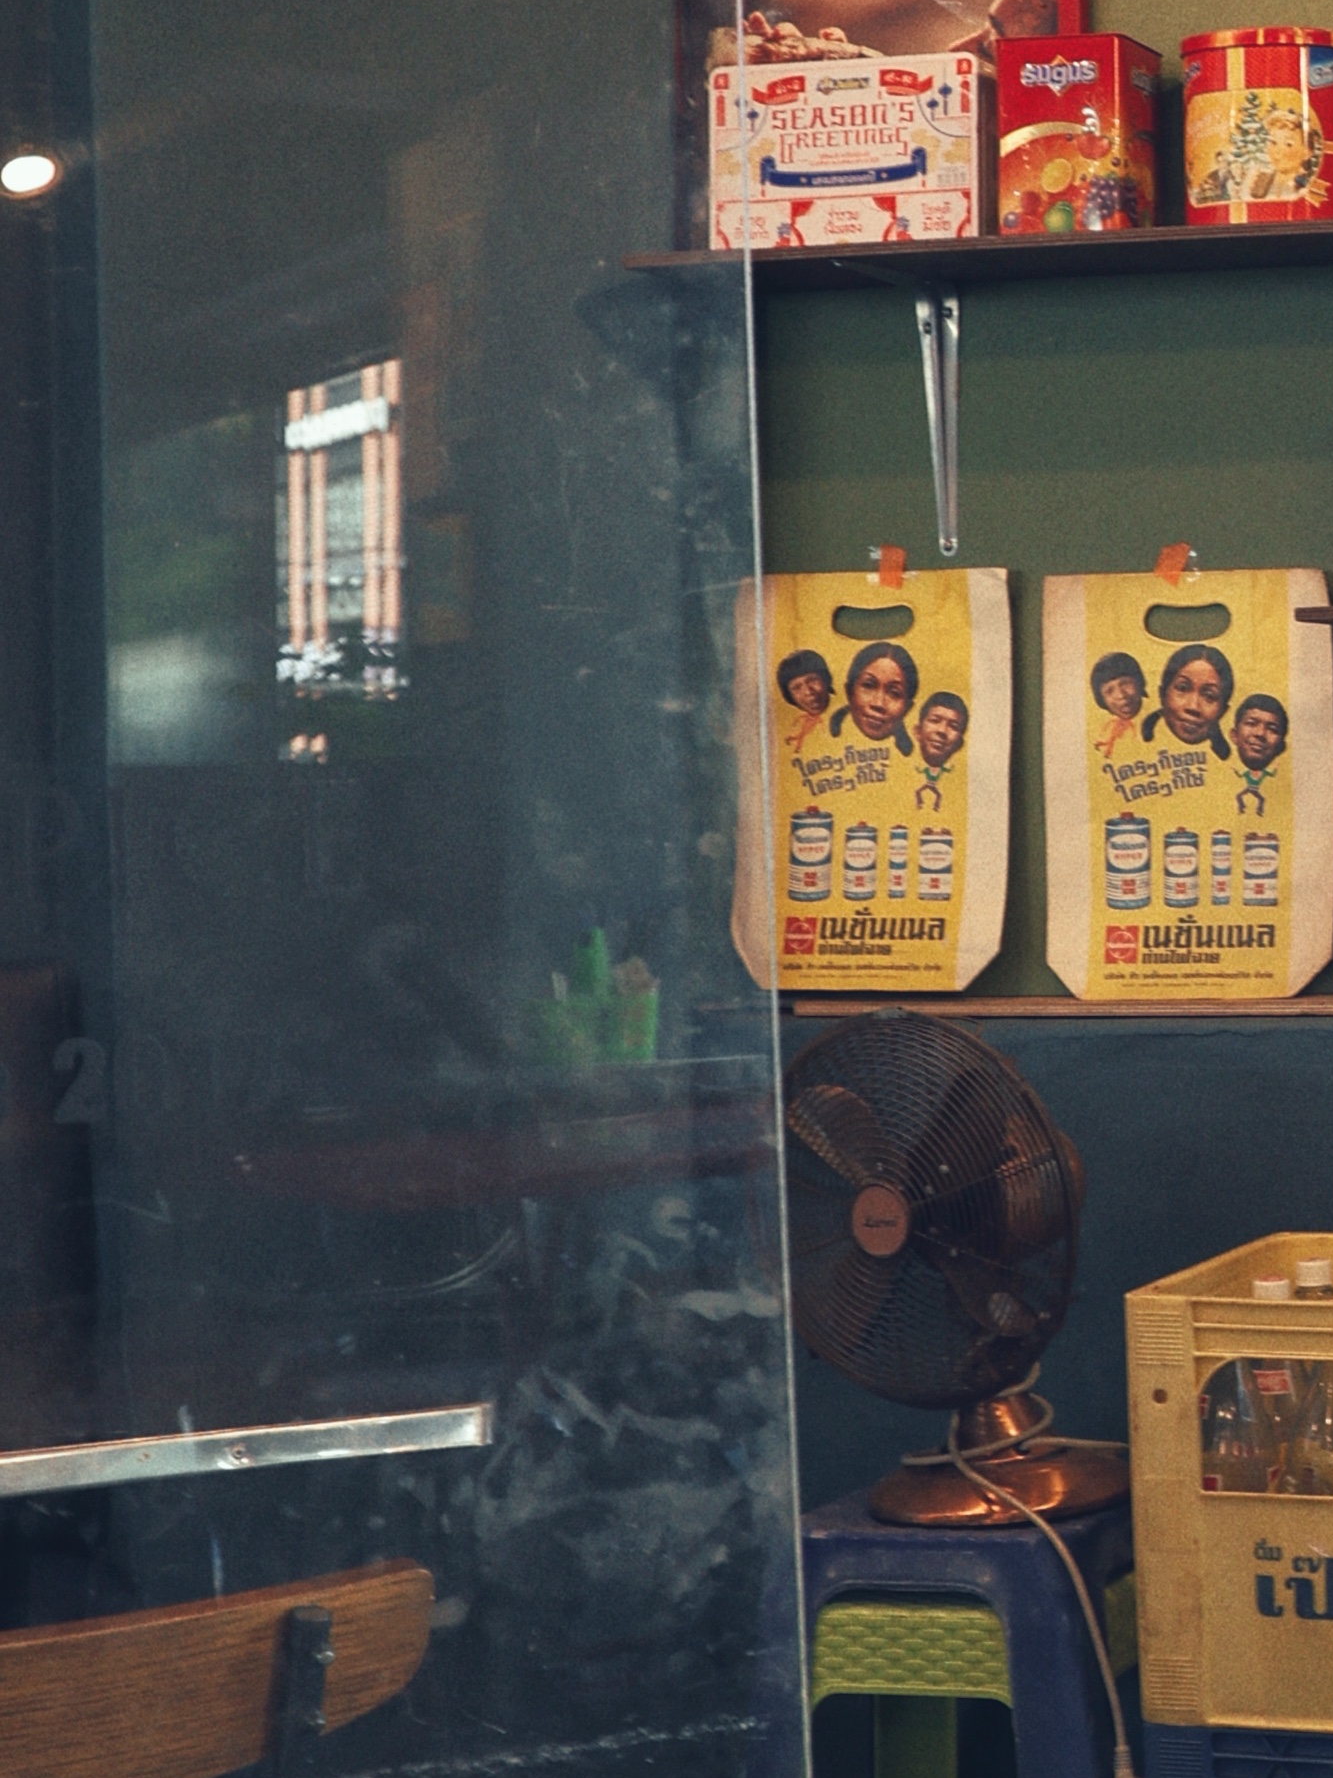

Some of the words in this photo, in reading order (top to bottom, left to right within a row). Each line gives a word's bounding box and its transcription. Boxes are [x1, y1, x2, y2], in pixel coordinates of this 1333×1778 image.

[1020, 59, 1098, 90] sugus
[772, 101, 914, 130] SEASON'S
[780, 126, 909, 163] GREETINGS
